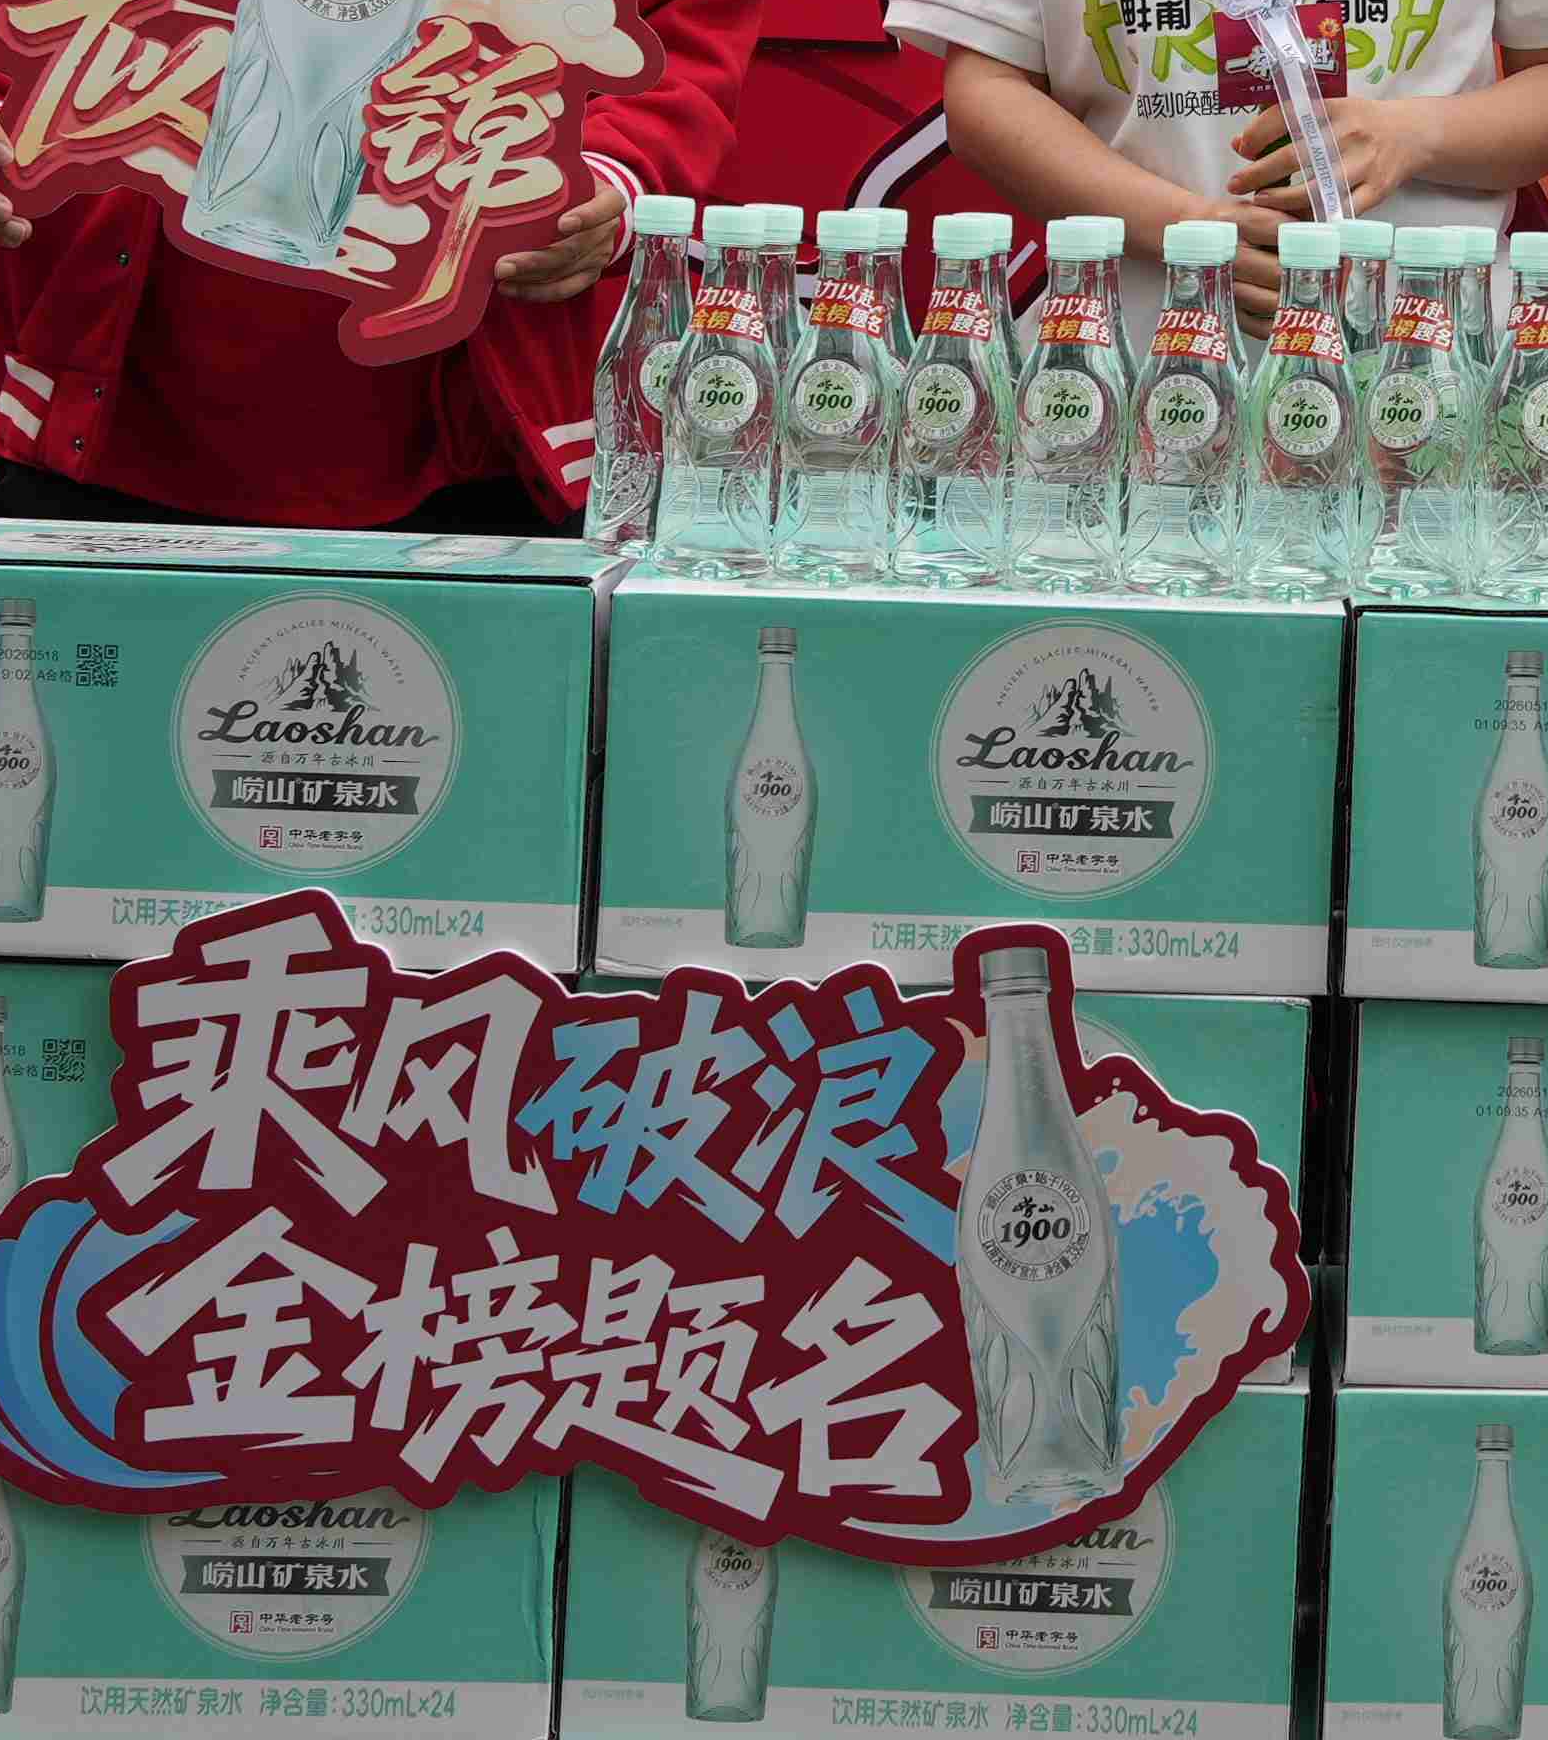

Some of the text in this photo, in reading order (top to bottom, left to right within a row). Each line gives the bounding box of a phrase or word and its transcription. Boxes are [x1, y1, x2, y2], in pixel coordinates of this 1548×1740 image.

[1138, 92, 1257, 118] 即刻唤醒
[699, 390, 744, 407] 1900
[808, 393, 852, 410] 1900
[917, 397, 960, 414] 1900
[1044, 403, 1089, 422] 1900
[1159, 408, 1204, 426] 1900
[1380, 407, 1421, 424] 1900
[1282, 414, 1327, 432] 1900
[199, 699, 439, 748] Laoshan
[957, 726, 1193, 772] Laoshan
[755, 783, 791, 797] 1900
[1502, 806, 1538, 820] 1900
[112, 896, 237, 928] 饮用天然
[871, 921, 974, 952] 饮用天然
[104, 940, 960, 1260] 乘风破浪
[1503, 1192, 1539, 1207] 1900
[1000, 1217, 1071, 1248] 1900
[107, 1215, 977, 1522] 金榜题名
[168, 1502, 409, 1530] Laoshan
[714, 1557, 751, 1572] 1900
[1472, 1578, 1508, 1593] 1900
[80, 1684, 242, 1716] 饮用天然矿泉水
[831, 1694, 989, 1729] 饮用天然矿泉水
